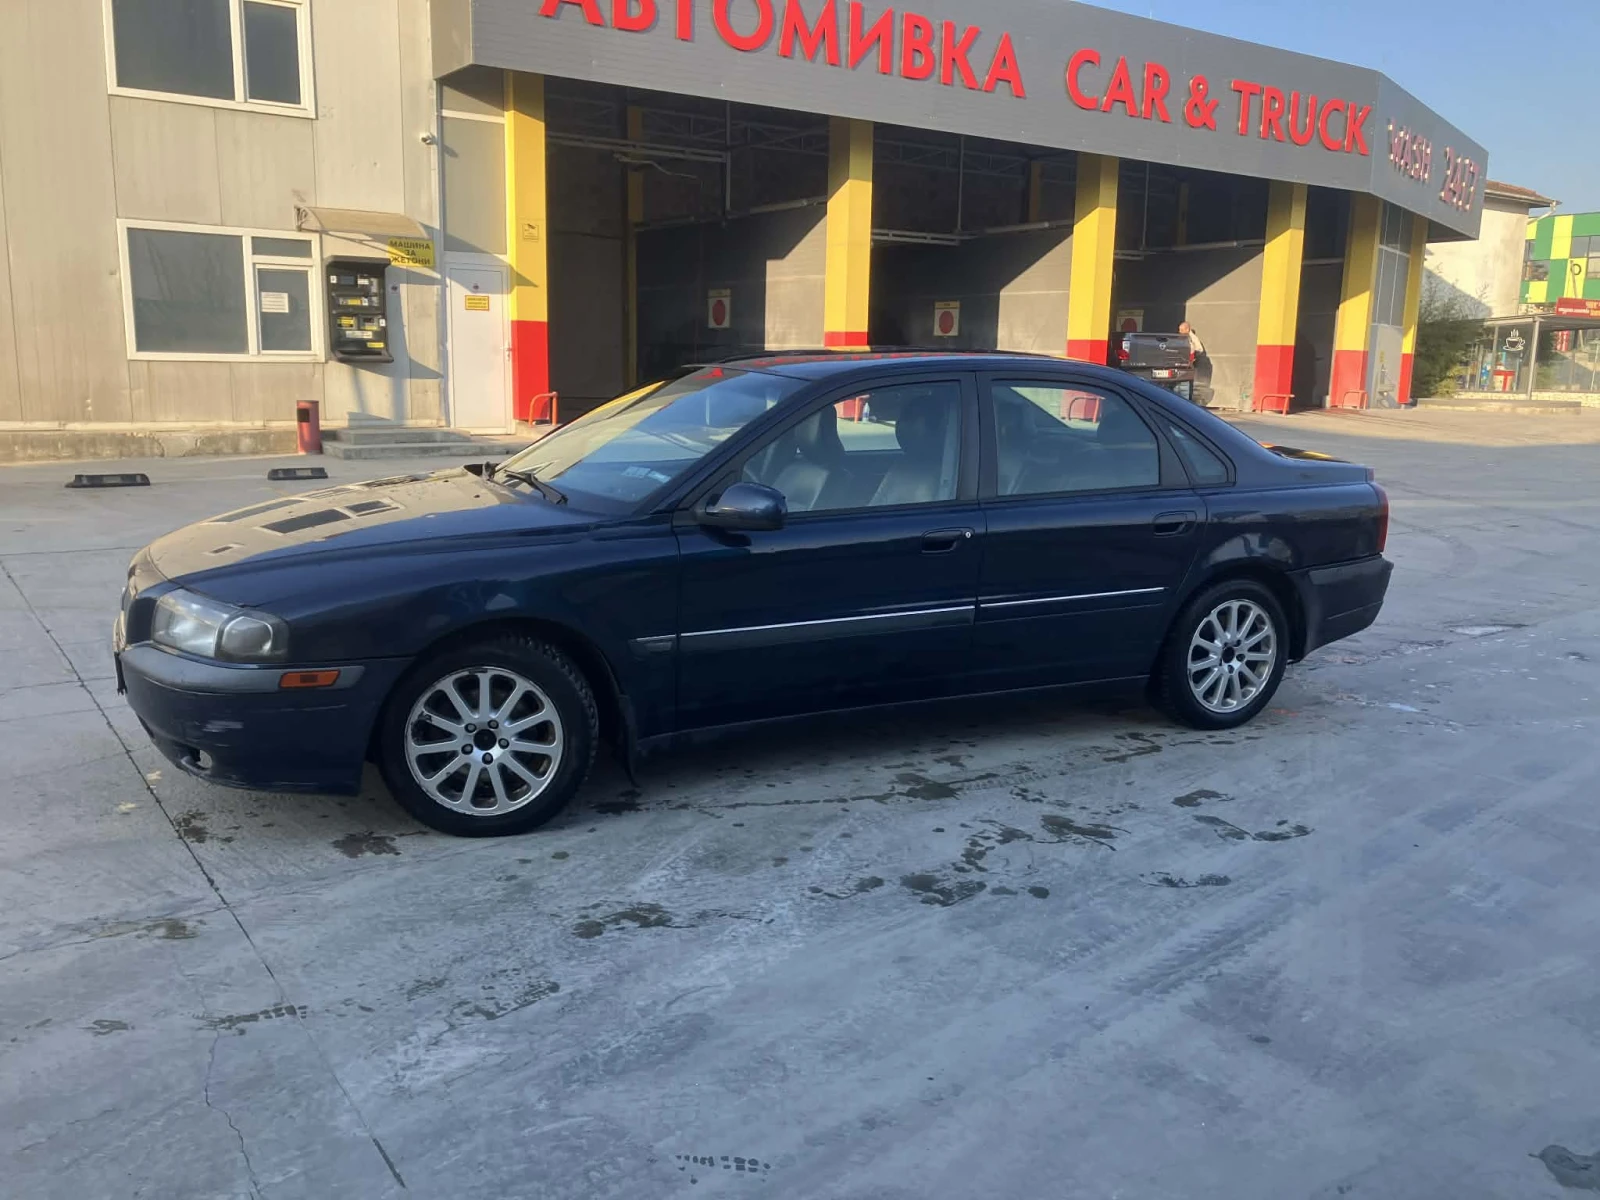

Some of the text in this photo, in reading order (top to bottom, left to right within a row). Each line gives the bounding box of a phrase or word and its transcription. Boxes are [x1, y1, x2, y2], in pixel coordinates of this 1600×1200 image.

[1067, 48, 1371, 156] CAR & TRUCK
[1388, 117, 1432, 181] WASH
[390, 240, 430, 250] МАШИНА
[405, 249, 416, 257] ЗА
[391, 256, 430, 265] ЖЕТОНИ
